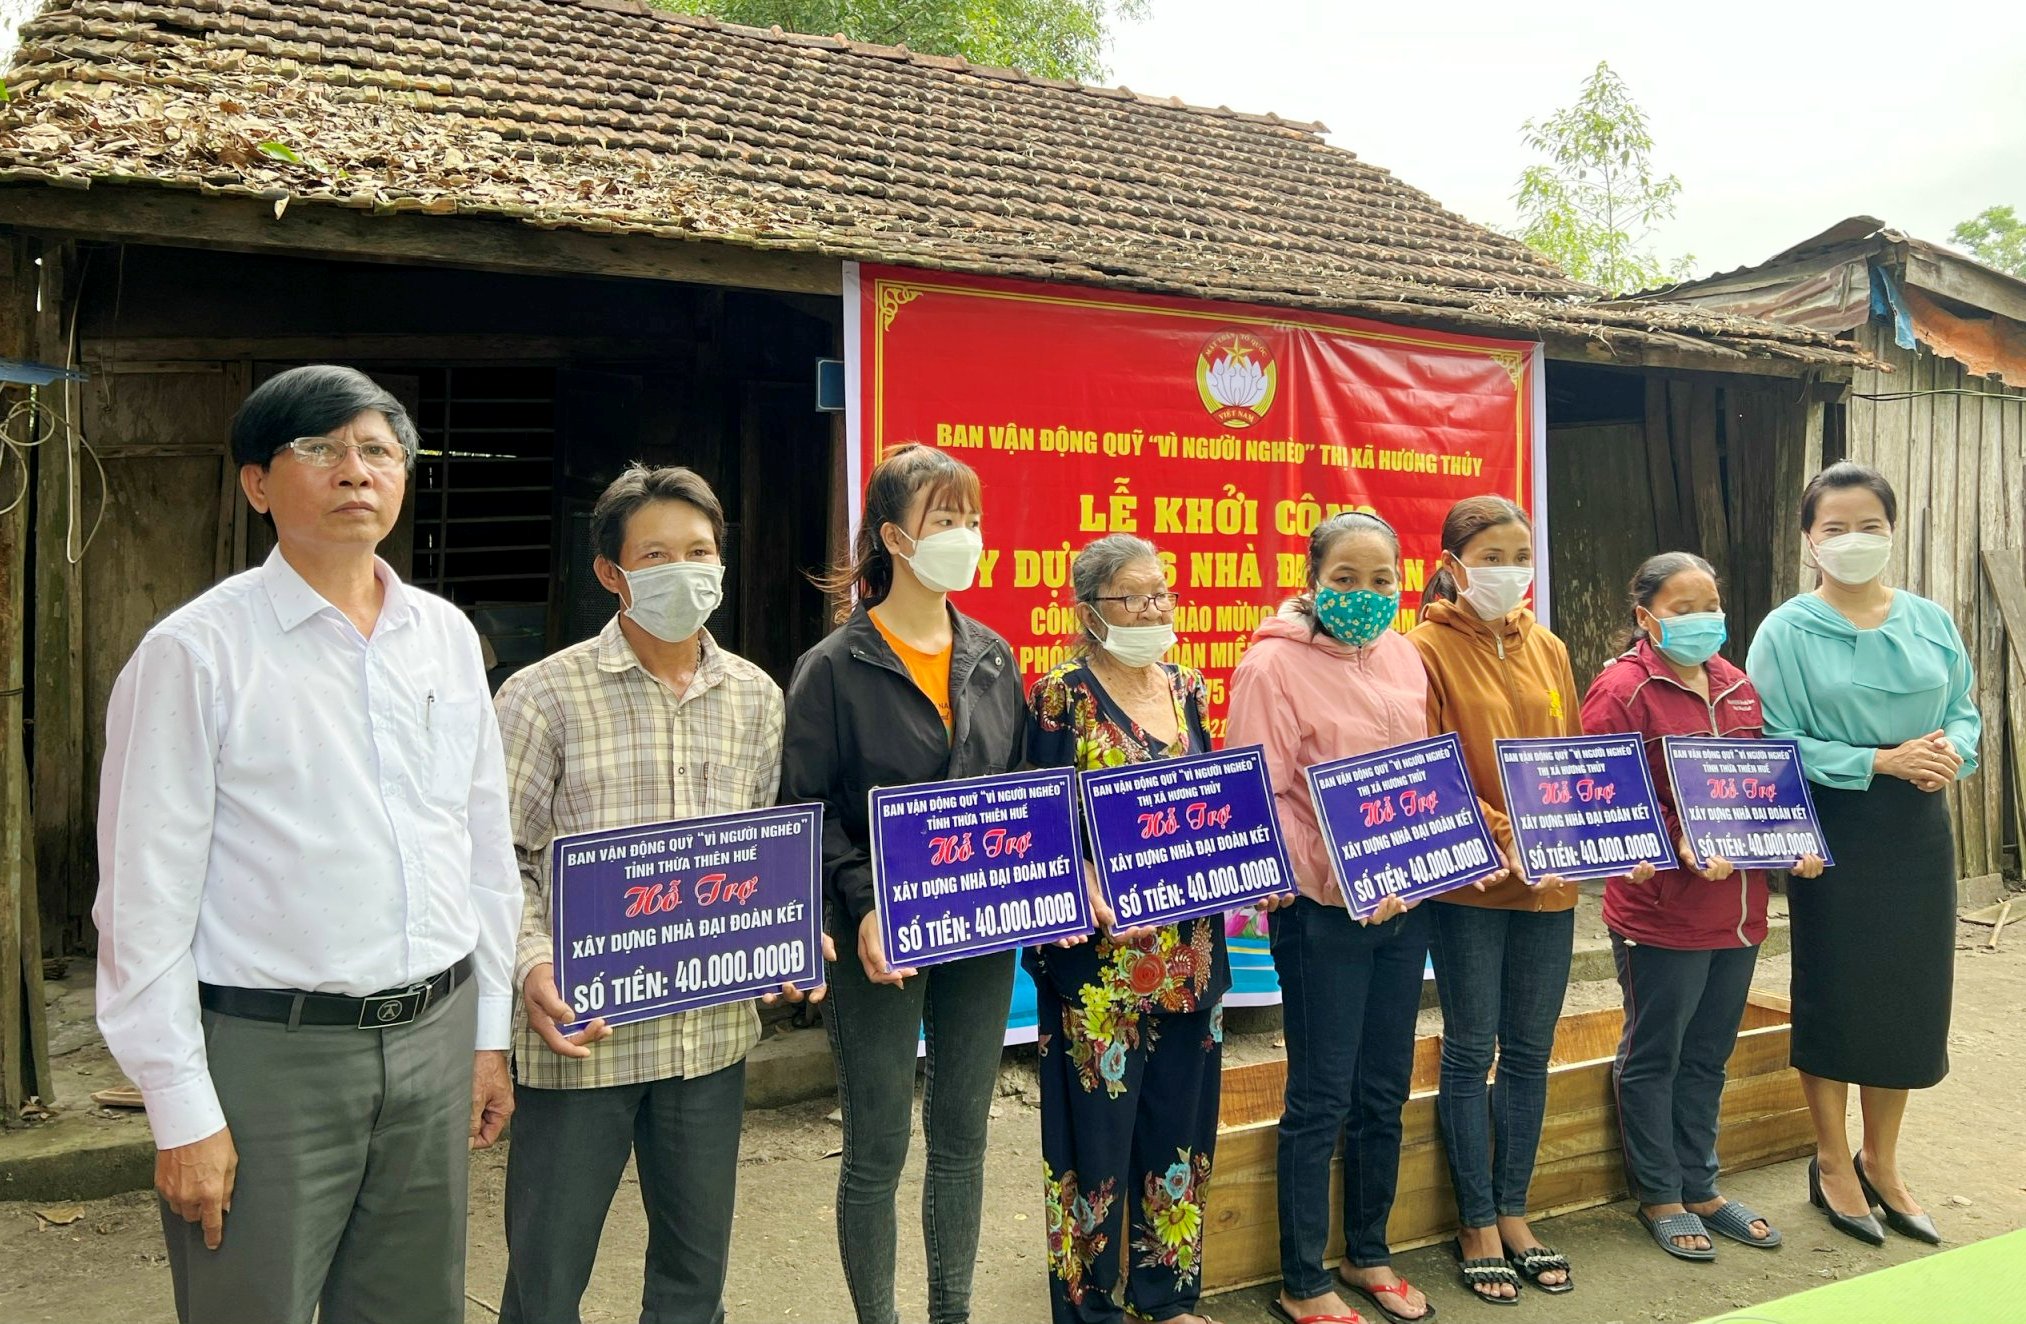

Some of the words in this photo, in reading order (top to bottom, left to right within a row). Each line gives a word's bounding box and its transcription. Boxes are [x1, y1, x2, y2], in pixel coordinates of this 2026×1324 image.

[1238, 411, 1254, 423] NAM
[937, 423, 983, 449] BAN
[989, 423, 1034, 455] VẬN
[1039, 425, 1097, 457] ĐỘNG
[1103, 429, 1144, 456] QUỸ
[1182, 434, 1241, 461] NGƯỜI
[1320, 444, 1348, 471] THỊ
[1351, 444, 1375, 469] XÃ
[1379, 450, 1437, 474] HƯƠNG
[1440, 451, 1482, 478] THỦY
[1080, 477, 1137, 532] LỄ
[1154, 484, 1258, 535] KHỞI
[1275, 493, 1377, 537] CÔ
[1191, 544, 1262, 588] NHÀ
[1173, 600, 1212, 633] HÀO
[1167, 637, 1206, 669] OÀN
[1211, 635, 1251, 669] MIỀ
[1093, 784, 1112, 797] BAN
[1114, 780, 1132, 795] VẬN
[1134, 775, 1158, 791] ĐỘNG
[1161, 771, 1178, 785] QUỸ
[1195, 763, 1222, 779] NGƯỜI
[1137, 795, 1153, 807] THỊ
[1155, 791, 1167, 804] XÃ
[1169, 786, 1198, 801] HƯƠNG
[1199, 781, 1221, 795] THỦY
[883, 802, 904, 817] BAN
[907, 799, 927, 816] VẬN
[930, 795, 957, 812] ĐỘNG
[959, 791, 978, 806] QUỸ
[998, 787, 1027, 801] NGƯỜI
[927, 815, 950, 830] TỈNH
[952, 812, 978, 826] THỪA
[980, 808, 1007, 824] THIÊN
[1010, 804, 1028, 819] HUẾ
[1138, 807, 1180, 839] Hỗ
[1186, 803, 1232, 829] Trợ
[1360, 796, 1396, 827] Hỗ
[1400, 791, 1438, 816] Trợ
[568, 851, 596, 866] BAN
[600, 846, 626, 863] VẬN
[630, 840, 666, 858] ĐỘNG
[669, 833, 693, 851] QUỸ
[720, 826, 758, 844] NGƯỜI
[929, 832, 974, 865] Hỗ
[983, 829, 1032, 858] Trợ
[1110, 853, 1132, 873] XÂY
[1136, 848, 1168, 868] DỰNG
[1170, 840, 1195, 860] NHÀ
[1197, 838, 1216, 858] ĐẠI
[1218, 831, 1248, 851] ĐOÀN
[1250, 824, 1270, 843] KẾT
[1342, 842, 1362, 860] XÂY
[1364, 837, 1390, 856] DỰNG
[1391, 827, 1412, 847] NHÀ
[1411, 825, 1430, 841] ĐẠI
[1432, 817, 1455, 835] ĐOÀN
[1457, 808, 1474, 826] KẾT
[625, 862, 654, 879] TỈNH
[658, 858, 690, 874] THỪA
[694, 851, 729, 868] THIÊN
[734, 845, 757, 862] HUẾ
[893, 880, 918, 902] XÂY
[922, 877, 957, 899] DỰNG
[960, 868, 987, 891] NHÀ
[990, 869, 1010, 888] ĐẠI
[1014, 861, 1046, 881] ĐOÀN
[1049, 854, 1070, 876] KẾT
[1354, 869, 1375, 902] SỐ
[1374, 864, 1411, 896] TIỀN:
[1409, 838, 1488, 884] 40.000.000Đ
[624, 880, 682, 918] Hỗ
[695, 874, 758, 906] Trợ
[1119, 884, 1142, 918] SỐ
[1143, 879, 1185, 912] TIỀN:
[1187, 857, 1281, 902] 40.000.000Đ
[572, 936, 606, 959] XÂY
[611, 928, 656, 951] DỰNG
[662, 921, 694, 943] NHÀ
[699, 918, 726, 937] ĐẠI
[730, 908, 772, 930] ĐOÀN
[777, 900, 804, 922] KẾT
[898, 915, 923, 953] SỐ
[926, 910, 971, 947] TIỀN:
[975, 892, 1077, 937] 40.000.000Đ
[574, 972, 605, 1013] SỐ
[612, 966, 668, 1005] TIỀN:
[675, 940, 804, 993] 40.000.000Đ
